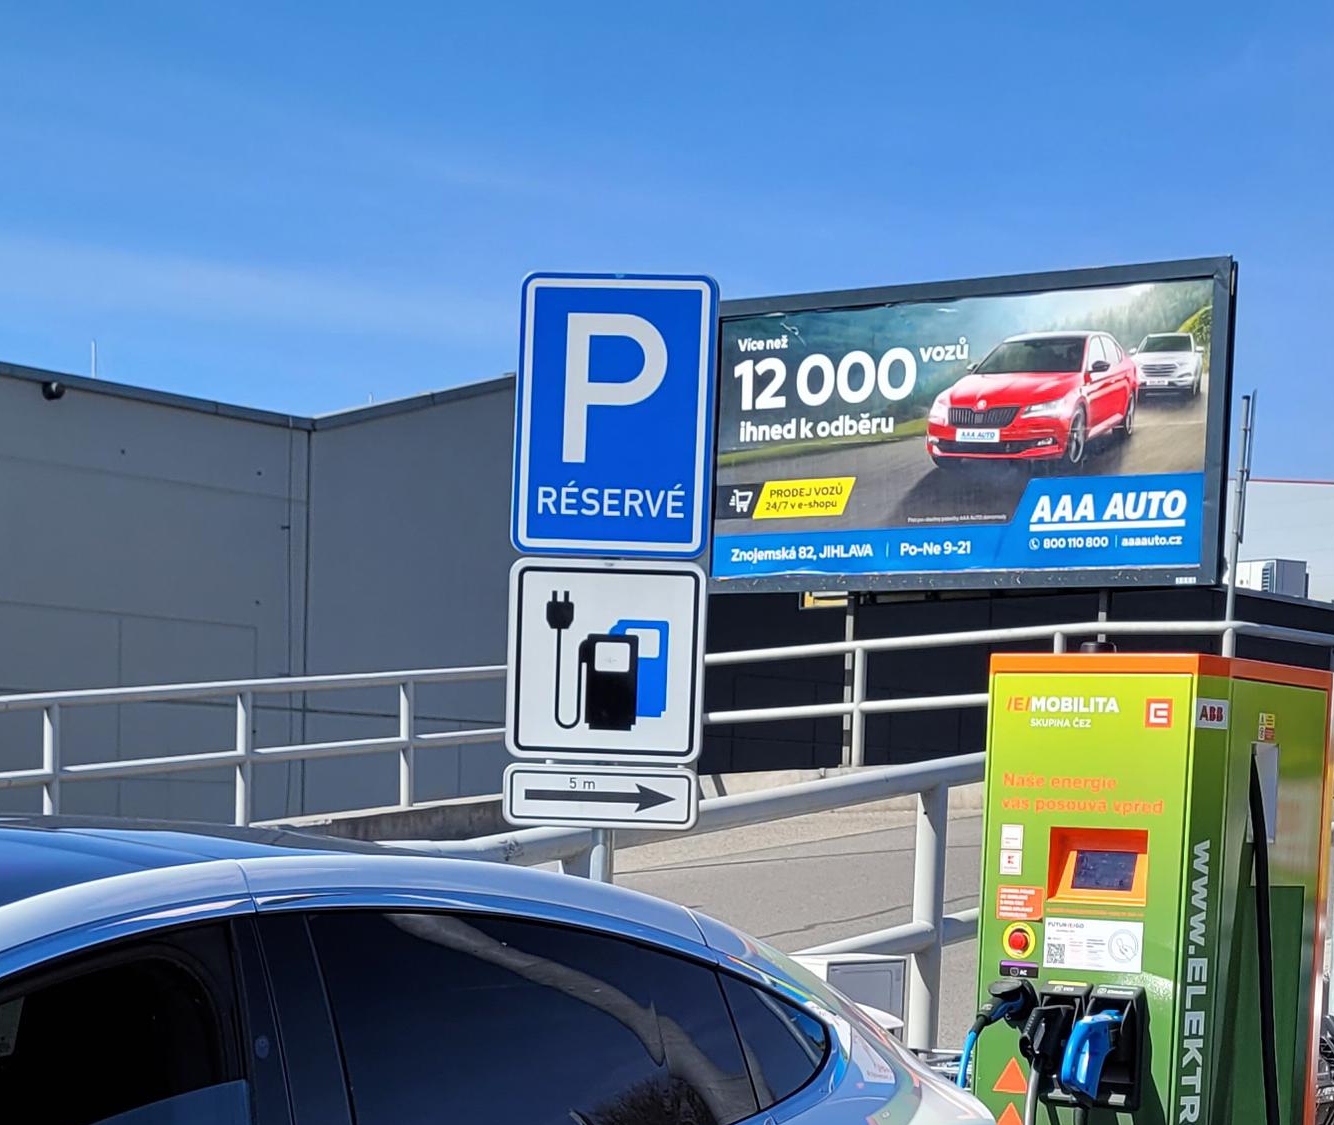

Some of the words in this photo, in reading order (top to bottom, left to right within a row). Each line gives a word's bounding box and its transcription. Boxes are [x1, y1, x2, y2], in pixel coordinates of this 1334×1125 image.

[738, 338, 764, 353] Více
[766, 335, 789, 350] než
[919, 337, 969, 362] vozů
[562, 312, 668, 463] P
[734, 357, 786, 411] 12
[796, 347, 917, 406] 000
[739, 417, 799, 443] ihned
[800, 417, 813, 438] k
[816, 413, 895, 438] odběru
[769, 487, 812, 498] PRODEJ
[814, 482, 844, 496] VOZŮ
[537, 481, 686, 519] RÉSERVÉ
[765, 502, 788, 511] 24/7
[798, 498, 837, 510] e-shopu
[1030, 493, 1095, 523] AAA
[1104, 489, 1187, 521] AUTO
[900, 542, 941, 556] Po-Ne
[943, 541, 971, 555] 9-21
[1043, 538, 1066, 549] 800
[1067, 537, 1085, 548] 110
[1085, 536, 1109, 548] 800
[731, 546, 797, 563] Znojemská
[798, 548, 817, 561] 82,
[819, 544, 873, 558] JIHLAVA
[1030, 719, 1070, 728] SKUPINA
[1072, 717, 1092, 728] ČEZ
[1199, 705, 1223, 722] ABB
[569, 777, 581, 790] 5
[583, 780, 596, 790] m
[1003, 772, 1045, 788] Naše
[1051, 775, 1117, 793] energie
[1034, 798, 1107, 814] posouvá
